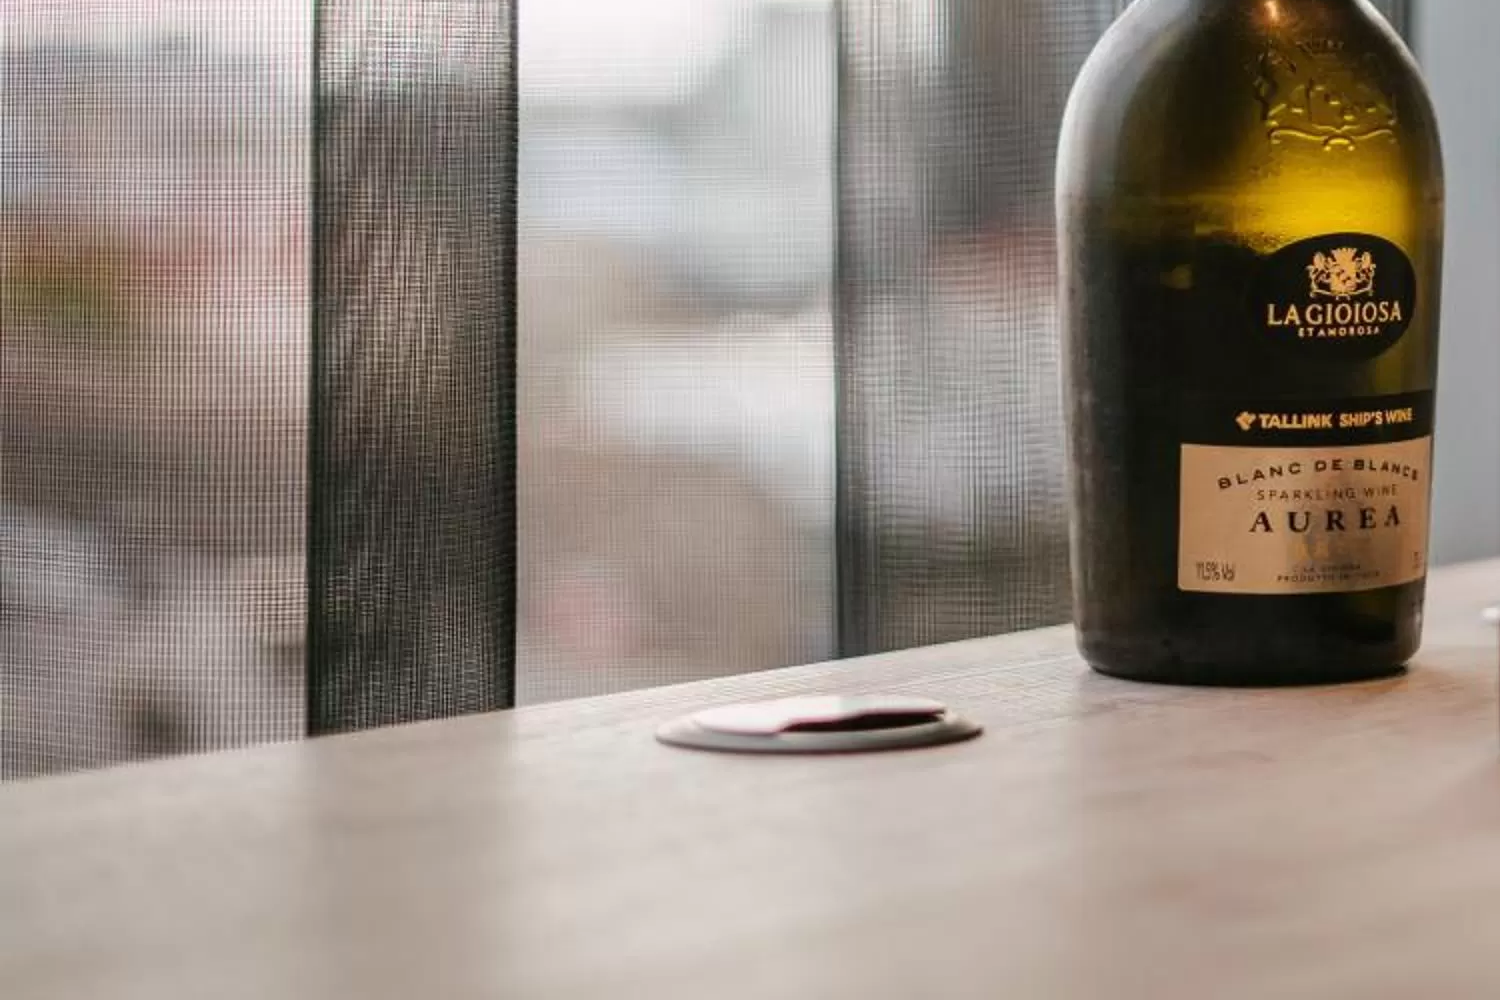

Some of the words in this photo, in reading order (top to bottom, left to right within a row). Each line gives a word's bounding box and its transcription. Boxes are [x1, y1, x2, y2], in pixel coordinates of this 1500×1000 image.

[1267, 304, 1300, 325] LA
[1305, 301, 1402, 325] GIOIOSA
[1298, 327, 1314, 338] ET
[1259, 413, 1333, 429] TALLINK
[1339, 411, 1383, 427] SHIP'S
[1385, 408, 1413, 424] WINE
[1217, 462, 1302, 489] BLANC
[1314, 459, 1344, 472] DE
[1256, 486, 1357, 501] SPARKLING
[1364, 484, 1398, 498] WINE
[1249, 505, 1401, 533] AUREA
